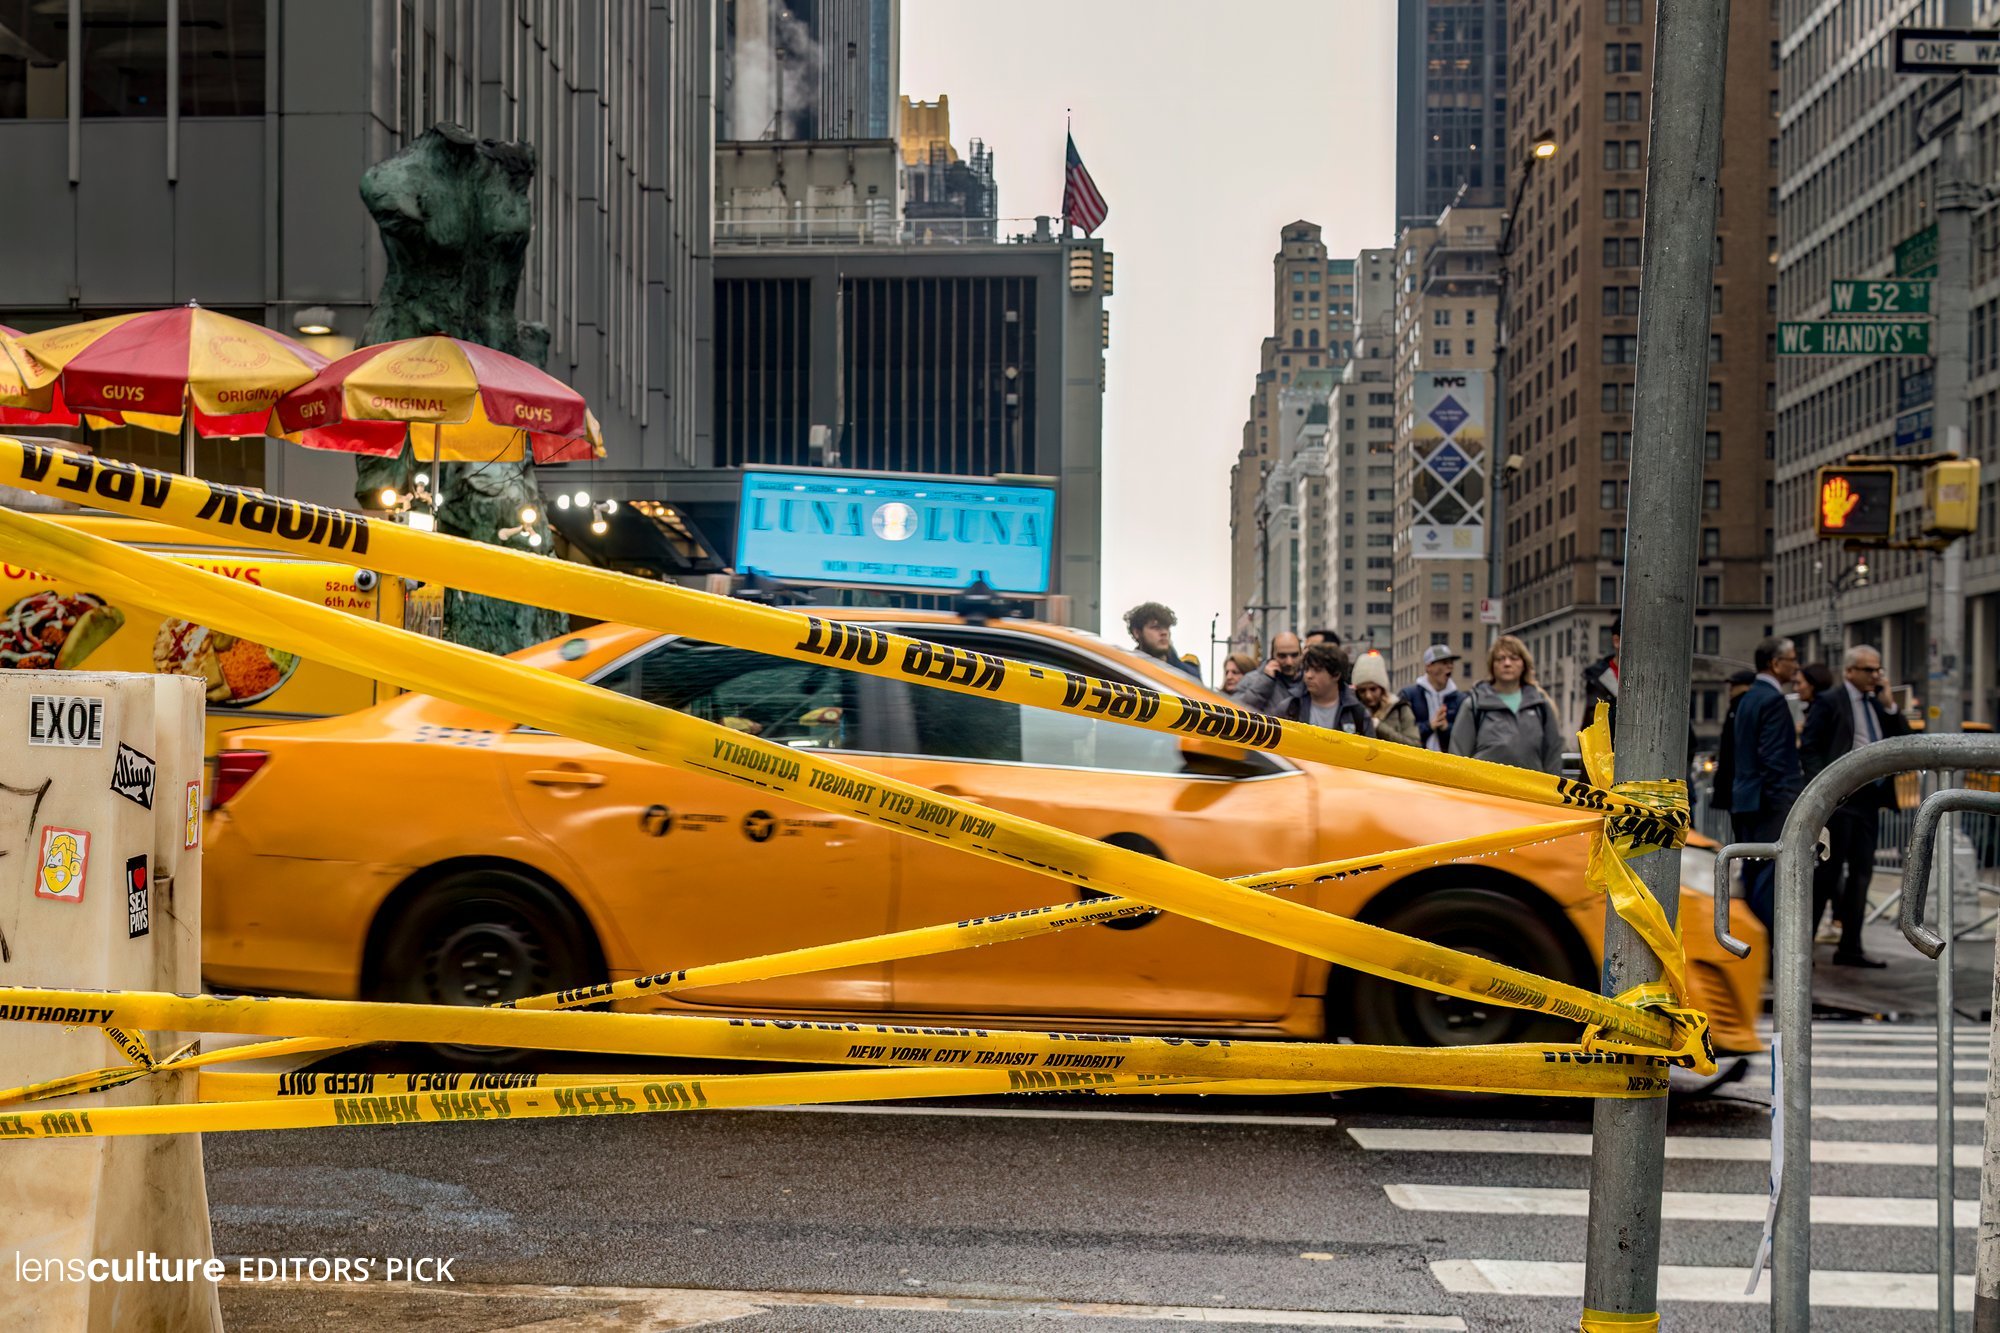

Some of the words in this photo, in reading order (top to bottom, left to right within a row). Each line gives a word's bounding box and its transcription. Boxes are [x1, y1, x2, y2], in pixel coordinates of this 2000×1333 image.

[1914, 43, 1956, 60] ONE
[1833, 283, 1854, 310] W
[1867, 284, 1900, 311] 52
[1910, 284, 1926, 299] ST
[1781, 324, 1812, 352] WC
[1823, 324, 1903, 353] HANDYS
[1907, 326, 1923, 340] PL
[102, 384, 145, 402] GUYS
[1433, 376, 1467, 388] NYC
[300, 400, 327, 418] GUYS
[371, 396, 447, 412] ORIGINAL
[515, 404, 553, 423] GUYS
[751, 496, 864, 537] LUNA
[923, 506, 1042, 547] LUNA
[325, 581, 357, 593] 52nd
[324, 596, 345, 608] 6th
[347, 597, 372, 609] Ave
[795, 616, 889, 666] OUT
[901, 641, 1006, 692] KEEP
[1061, 672, 1161, 722] AREA
[30, 696, 103, 745] EXOE
[1168, 696, 1283, 749] WORK
[129, 889, 148, 914] SEX
[130, 909, 149, 934] PAYS
[0, 1005, 115, 1023] AUTHORITY
[845, 1045, 887, 1059] NEW
[889, 1047, 932, 1061] YORK
[933, 1049, 971, 1063] CITY
[973, 1050, 1039, 1066] TRANSIT
[1042, 1053, 1126, 1069] AUTHORITY
[323, 1073, 376, 1094] KEEP
[1627, 1076, 1654, 1091] NEW
